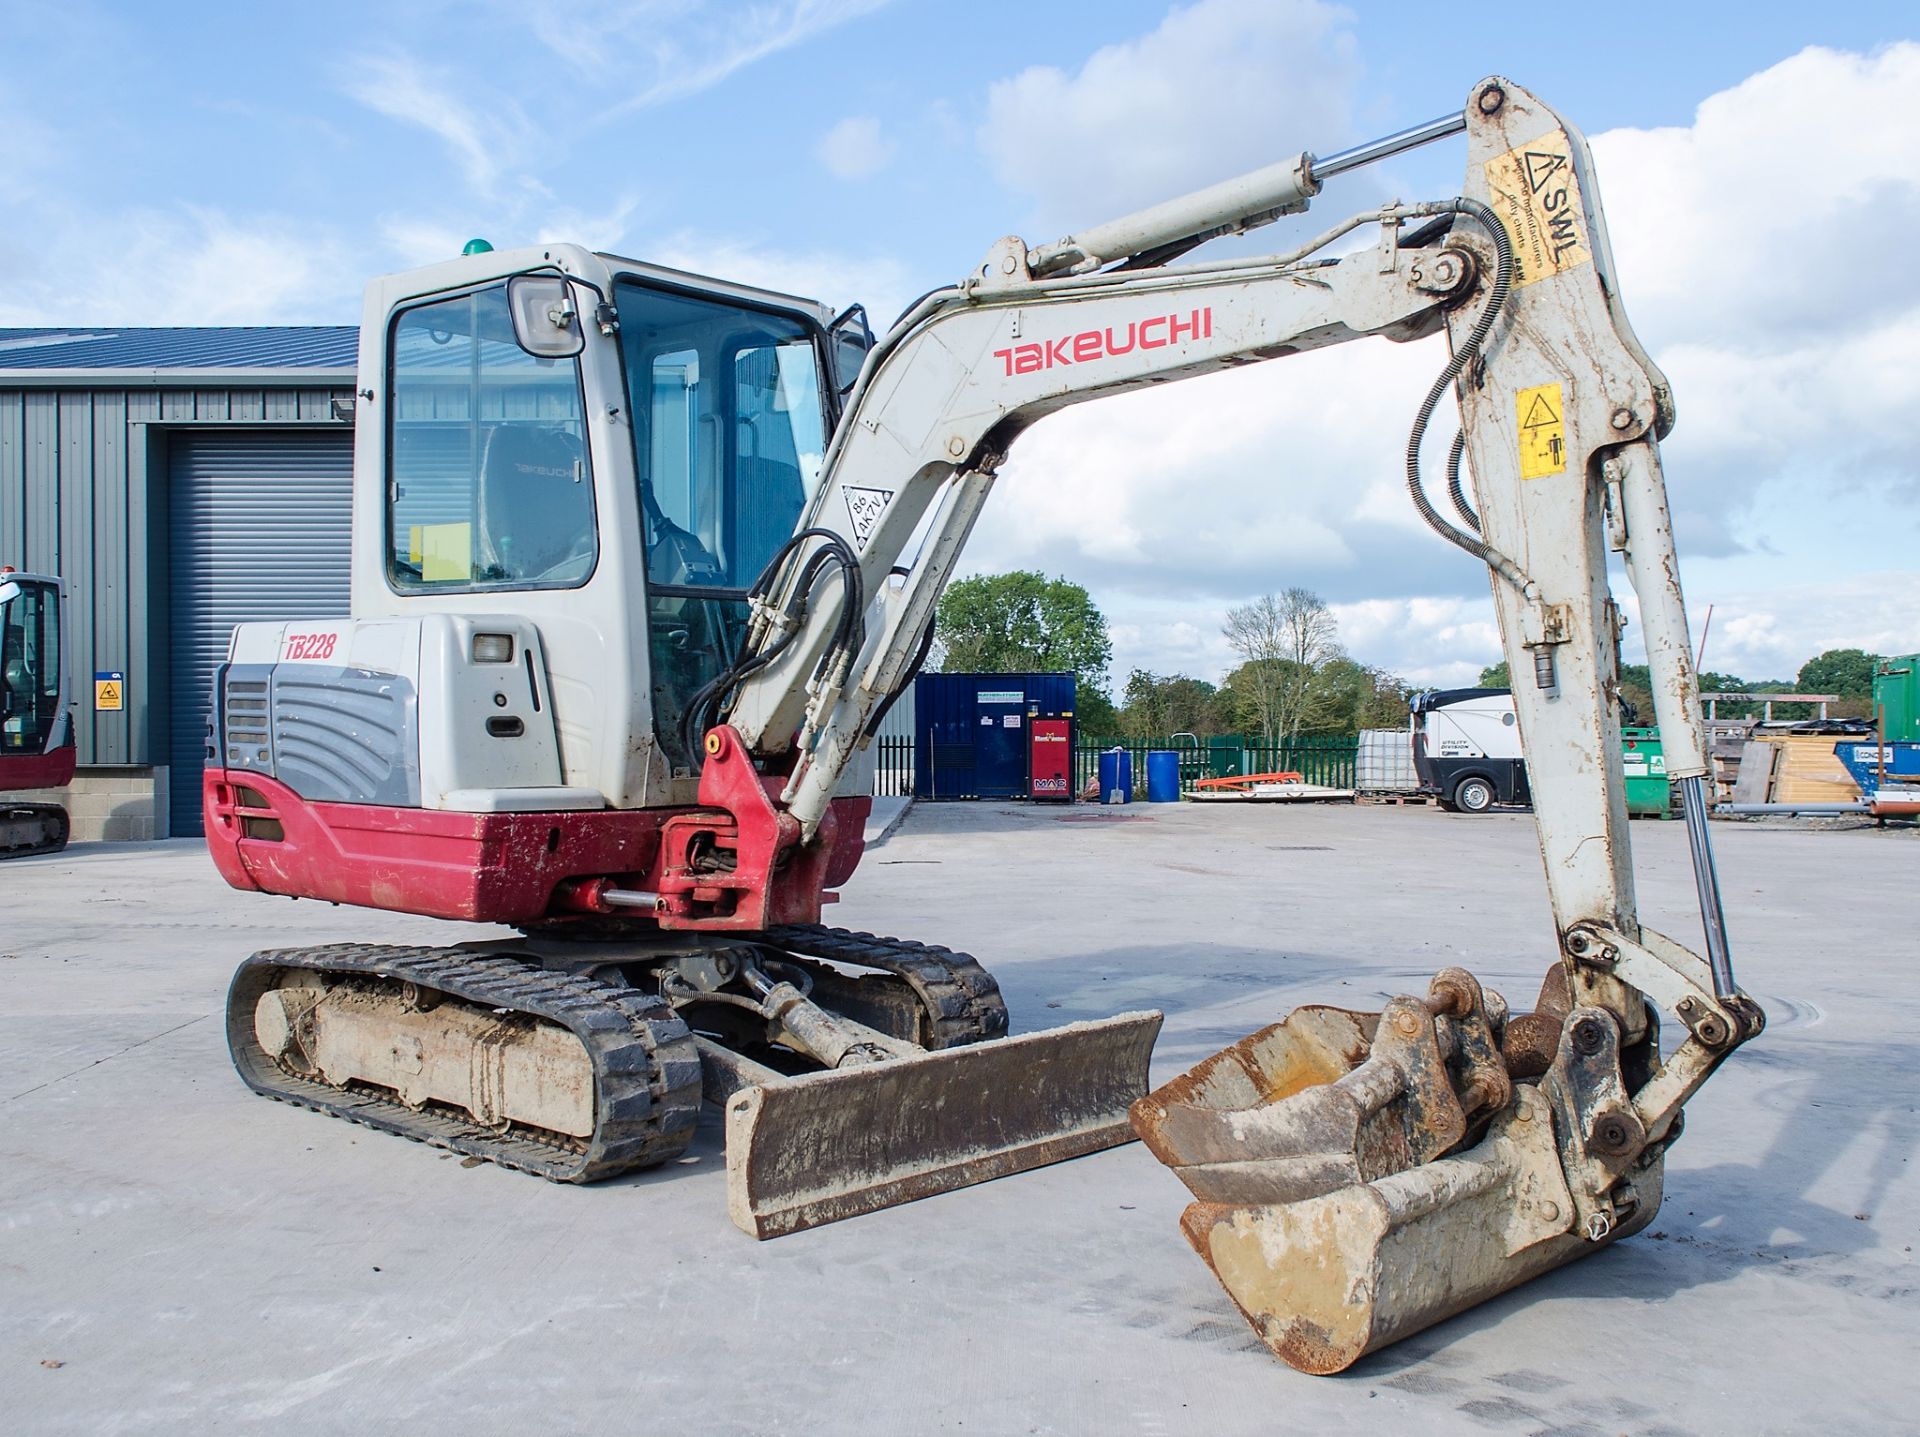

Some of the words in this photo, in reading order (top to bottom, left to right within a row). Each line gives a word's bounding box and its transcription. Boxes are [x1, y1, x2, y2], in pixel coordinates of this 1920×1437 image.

[1509, 194, 1518, 216] duty
[1513, 218, 1525, 249] charts
[1523, 198, 1543, 269] manufacturers
[1544, 188, 1576, 264] SWL
[853, 496, 867, 514] 86
[859, 495, 880, 534] AK7V
[286, 633, 337, 660] TB228
